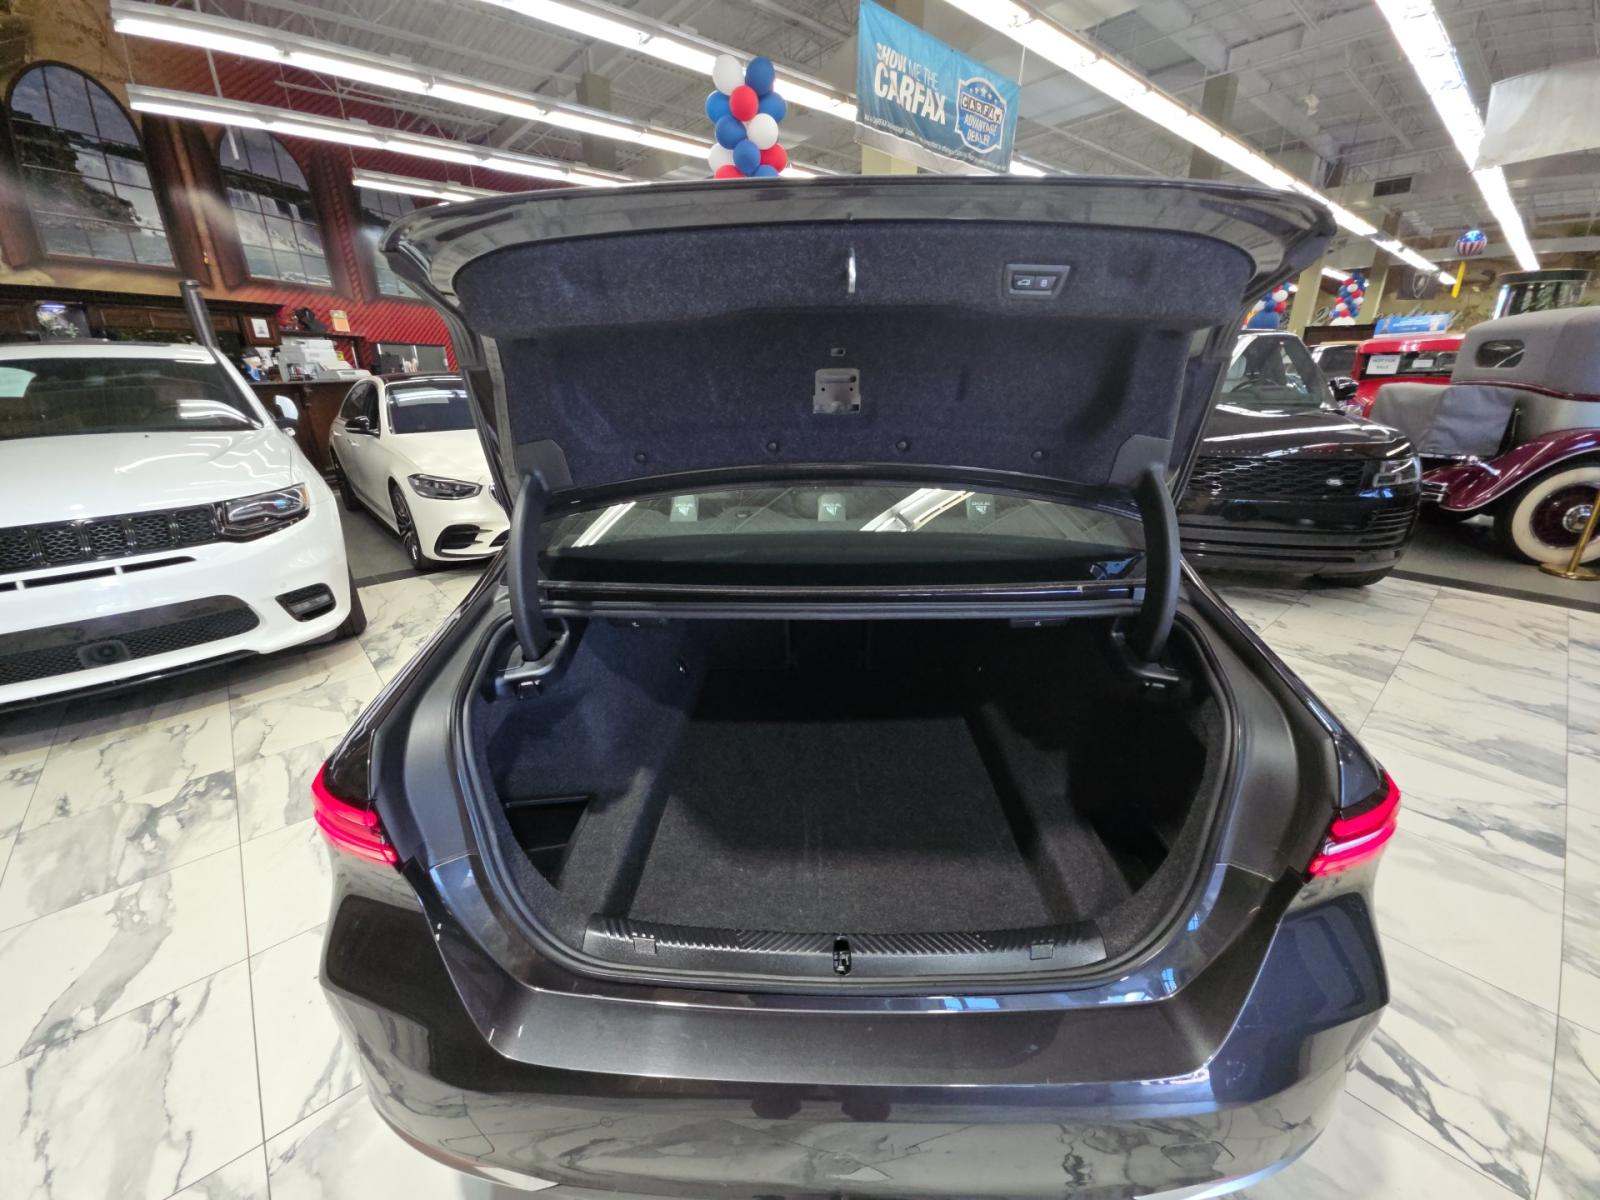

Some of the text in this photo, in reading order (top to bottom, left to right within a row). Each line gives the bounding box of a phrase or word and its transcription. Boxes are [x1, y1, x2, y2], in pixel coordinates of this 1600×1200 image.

[876, 42, 939, 92] SHOW ME THE
[874, 62, 946, 125] CARFAX
[962, 95, 1003, 125] CARFAX
